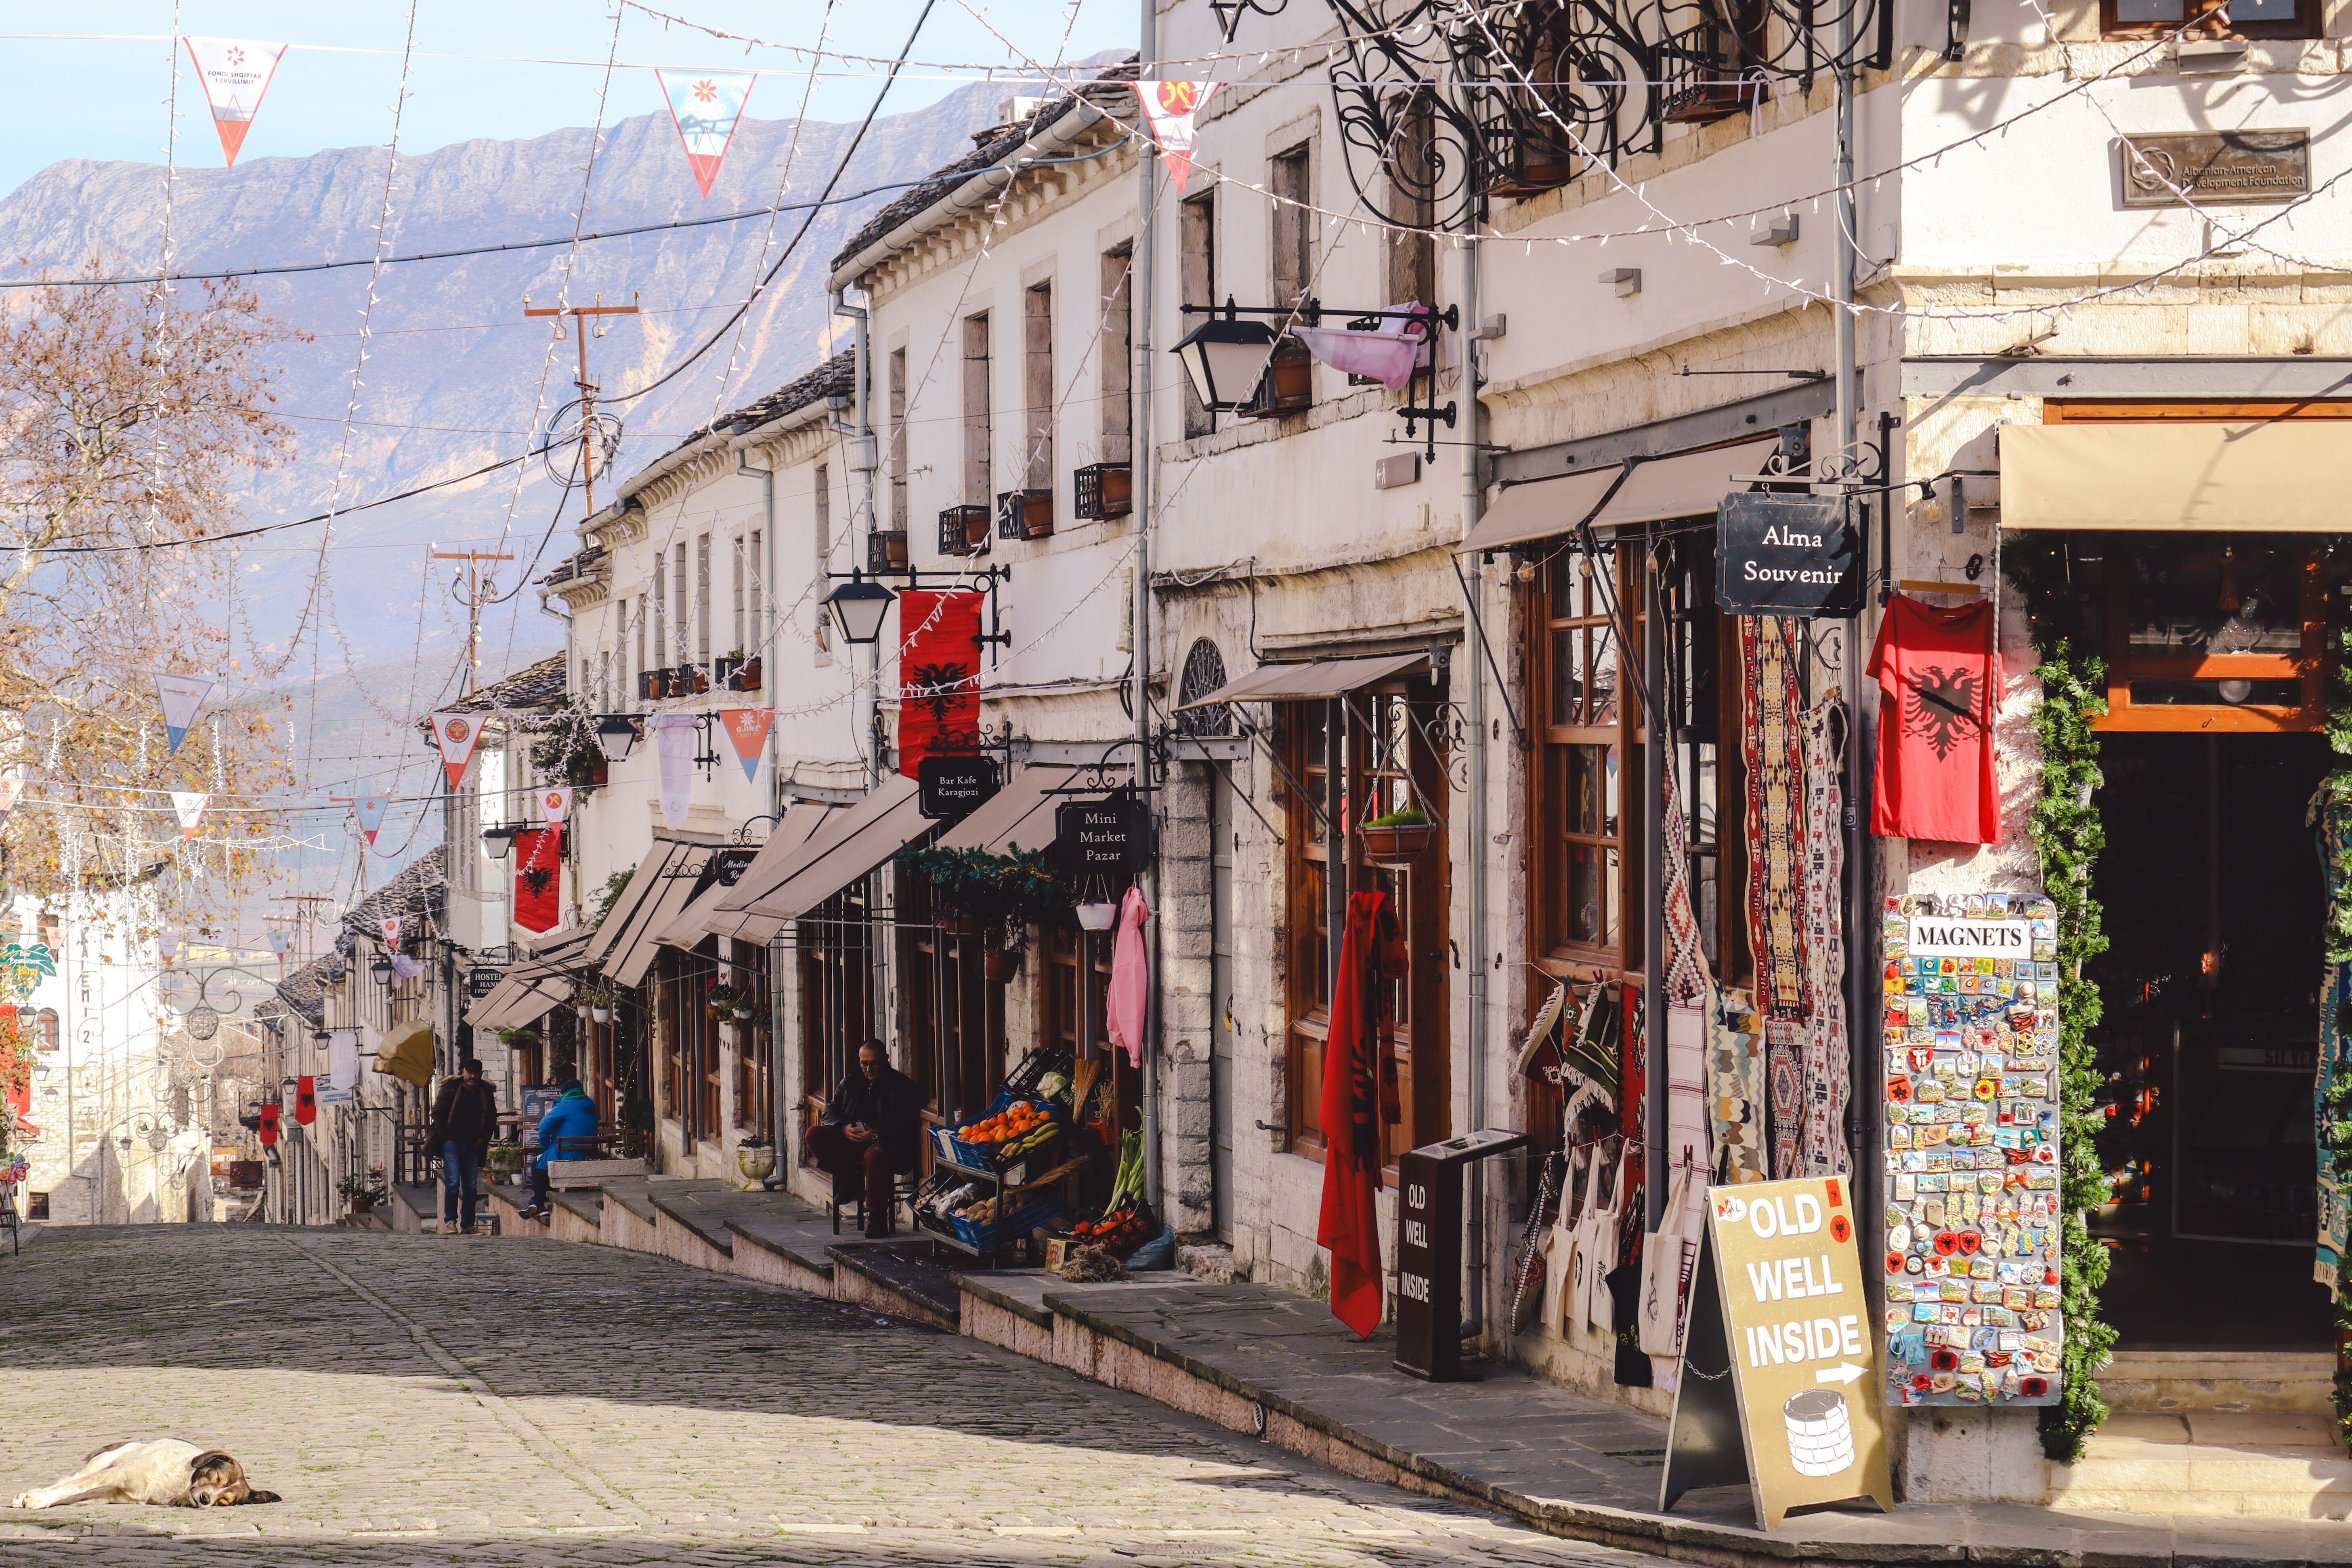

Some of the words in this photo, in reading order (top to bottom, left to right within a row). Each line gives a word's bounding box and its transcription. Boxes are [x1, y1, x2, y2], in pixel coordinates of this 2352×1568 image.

[2181, 164, 2276, 177] Albanian-American
[2181, 177, 2247, 189] Development
[2248, 174, 2303, 187] Foundation
[1761, 524, 1823, 548] Alma
[1744, 560, 1844, 584] Souvenir
[939, 776, 955, 784] Bar
[957, 776, 977, 784] Kafe
[938, 787, 979, 798] Karagjozi
[1085, 813, 1116, 824] Mini
[1080, 830, 1126, 843] Market
[1086, 850, 1121, 861] Pazar
[1917, 927, 2022, 947] MAGNETS
[83, 1030, 90, 1044] 2
[1408, 1183, 1426, 1210] OLD
[1750, 1193, 1822, 1239] OLD
[1406, 1219, 1428, 1249] WELL
[1402, 1271, 1429, 1304] INSIDE
[1746, 1254, 1844, 1303] WELL
[1746, 1314, 1863, 1368] INSIDE
